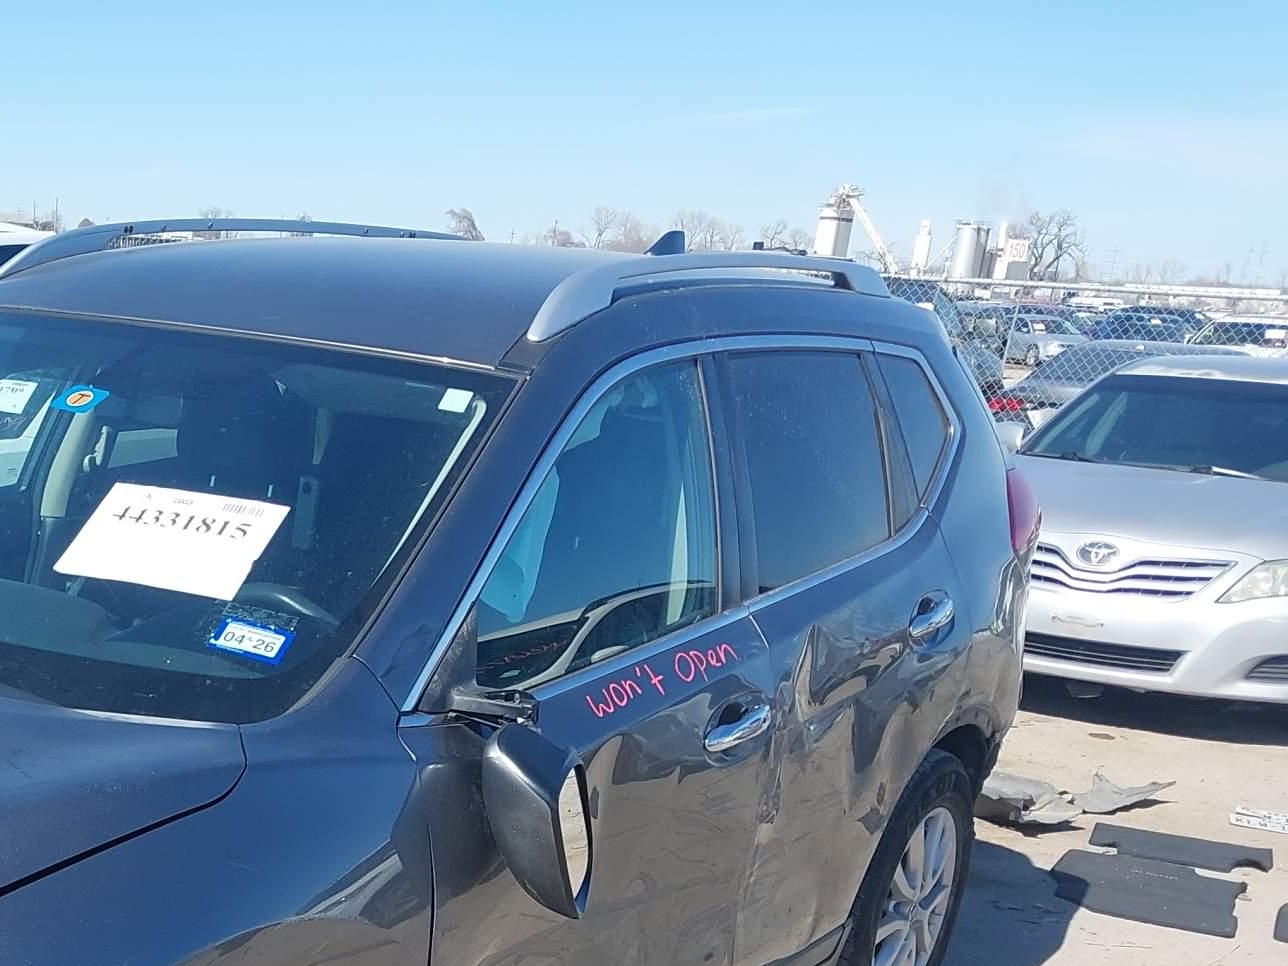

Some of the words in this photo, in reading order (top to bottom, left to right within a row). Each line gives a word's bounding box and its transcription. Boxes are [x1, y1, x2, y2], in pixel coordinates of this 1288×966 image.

[112, 506, 252, 539] 44331815
[223, 631, 245, 645] 04
[252, 638, 276, 653] 26
